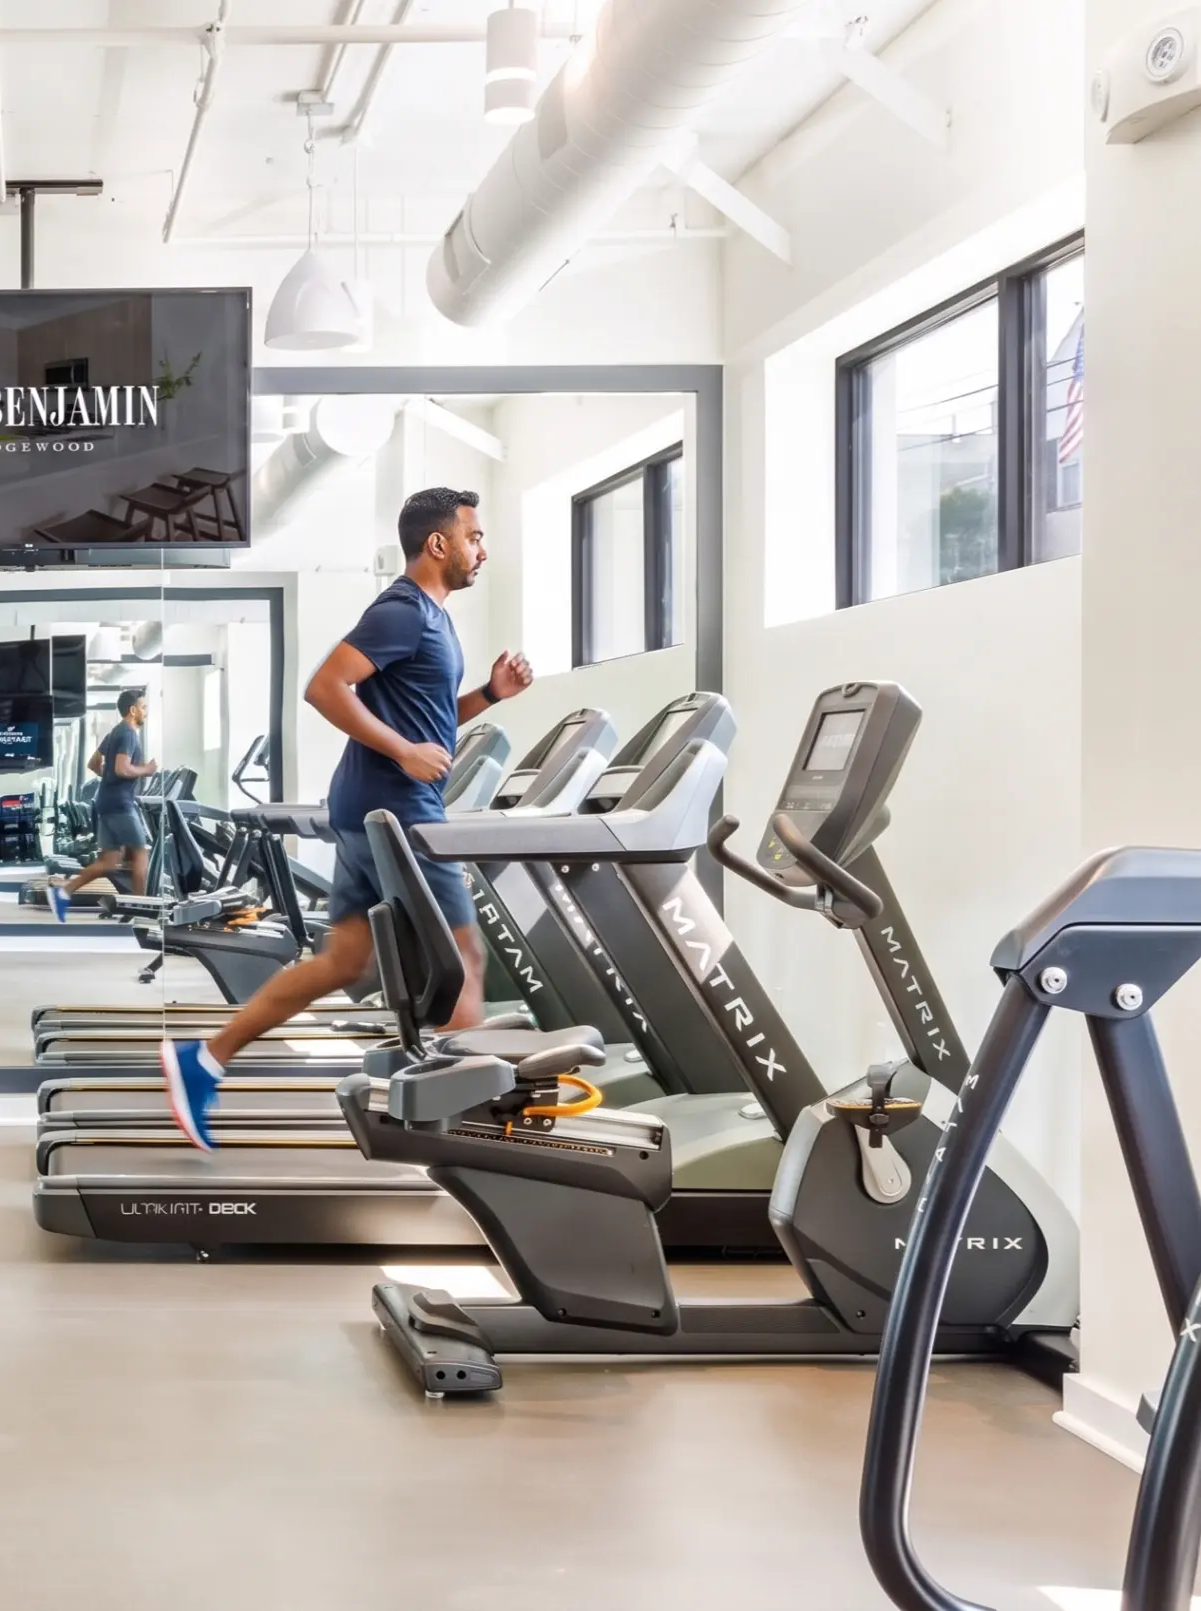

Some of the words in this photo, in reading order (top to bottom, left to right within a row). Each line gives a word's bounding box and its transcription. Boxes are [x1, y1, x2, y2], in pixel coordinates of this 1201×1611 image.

[662, 897, 787, 1082] MATRIX
[881, 926, 951, 1061] MATRIX
[209, 1202, 257, 1215] DECK
[894, 1237, 1023, 1250] MRIX
